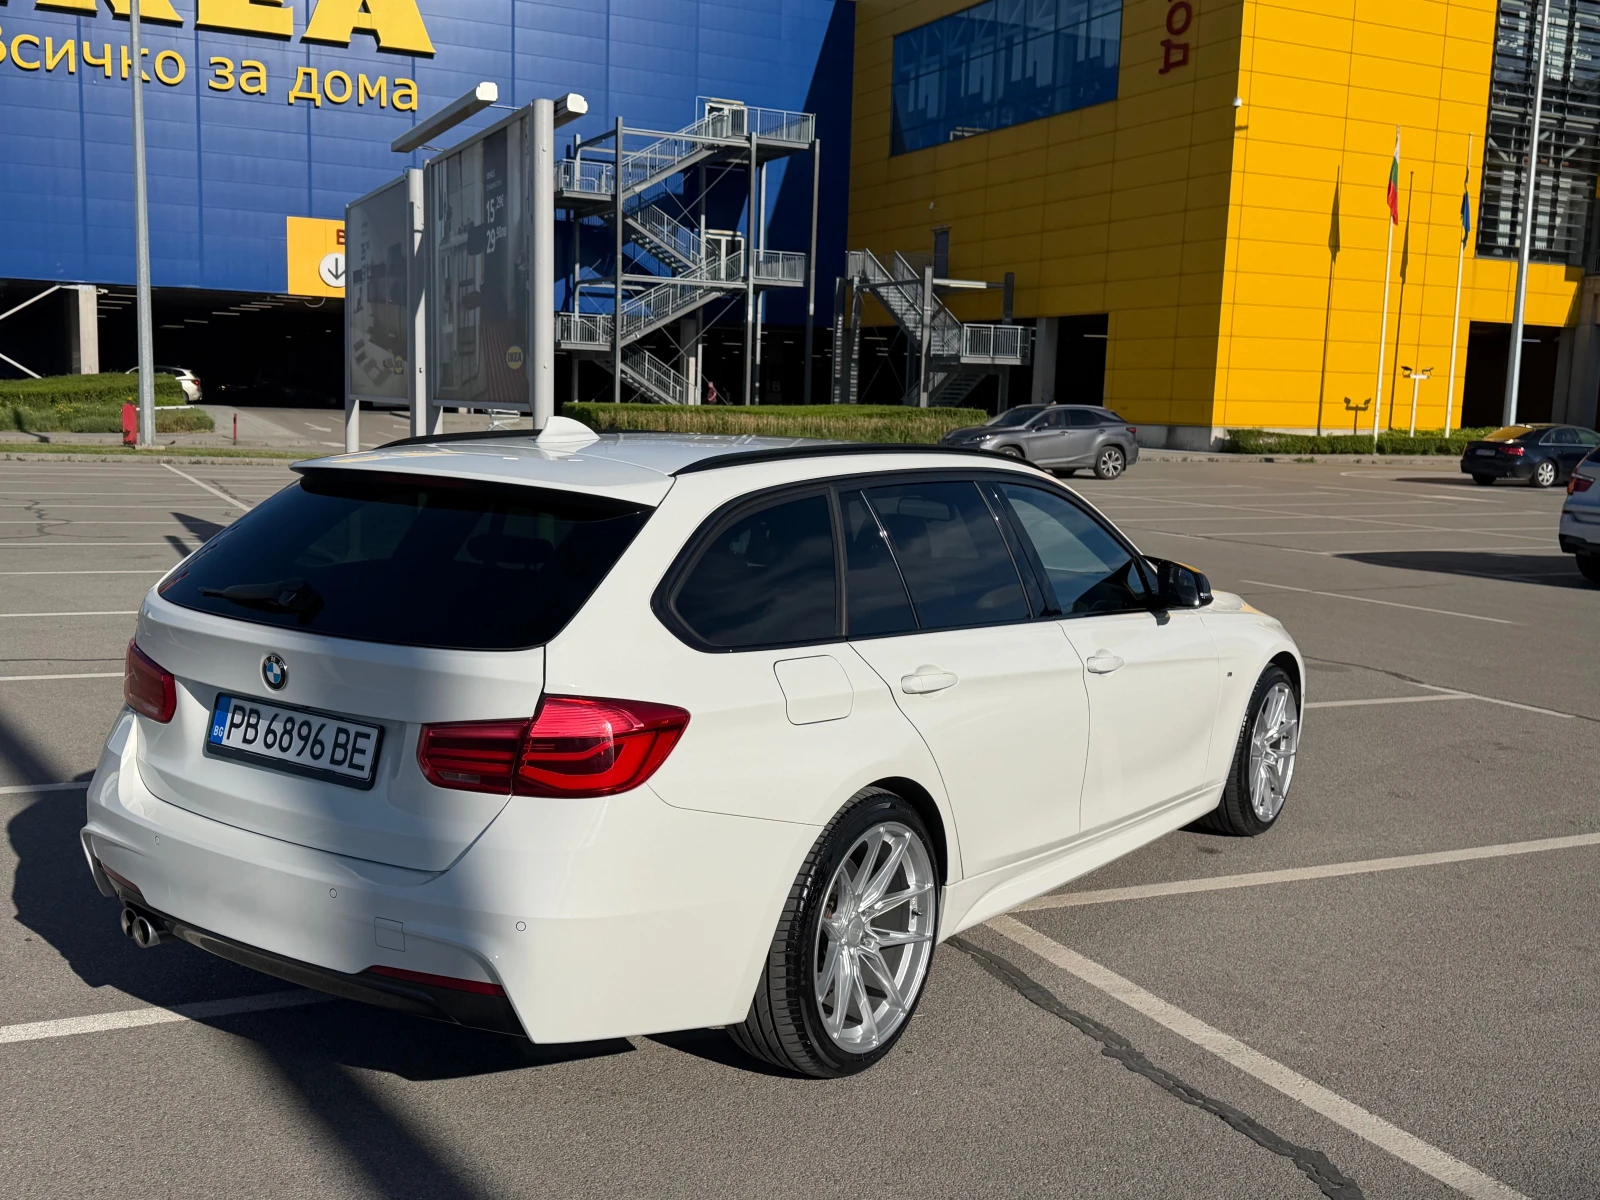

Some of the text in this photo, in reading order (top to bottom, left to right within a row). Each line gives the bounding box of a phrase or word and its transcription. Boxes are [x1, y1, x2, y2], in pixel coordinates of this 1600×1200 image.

[0, 25, 186, 86] сичко
[208, 56, 268, 95] за
[288, 66, 419, 111] дома
[213, 725, 224, 737] BG
[263, 713, 327, 761] 6896
[329, 727, 371, 772] BE
